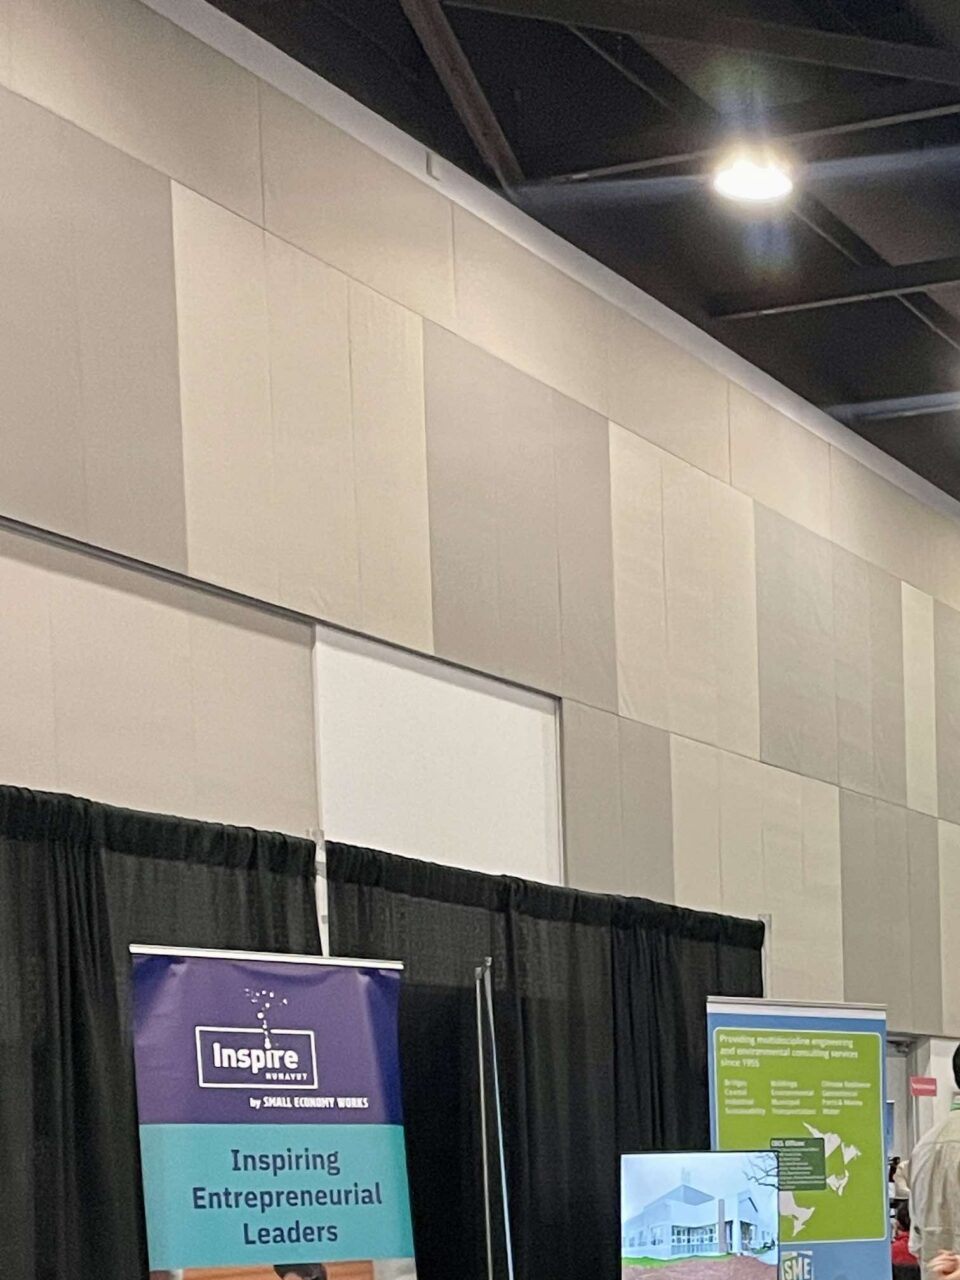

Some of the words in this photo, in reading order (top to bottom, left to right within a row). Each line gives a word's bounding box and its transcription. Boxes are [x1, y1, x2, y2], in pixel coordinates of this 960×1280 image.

[213, 1042, 298, 1073] Inspire
[720, 1047, 736, 1055] and
[249, 1097, 261, 1109] by
[263, 1096, 293, 1108] SMALL
[294, 1097, 336, 1108] ECONOMY
[337, 1097, 369, 1108] WORKS
[231, 1149, 341, 1176] Inspiring
[193, 1182, 382, 1213] Entrepreneurial
[243, 1221, 339, 1245] Leaders
[784, 1256, 811, 1280] SME
